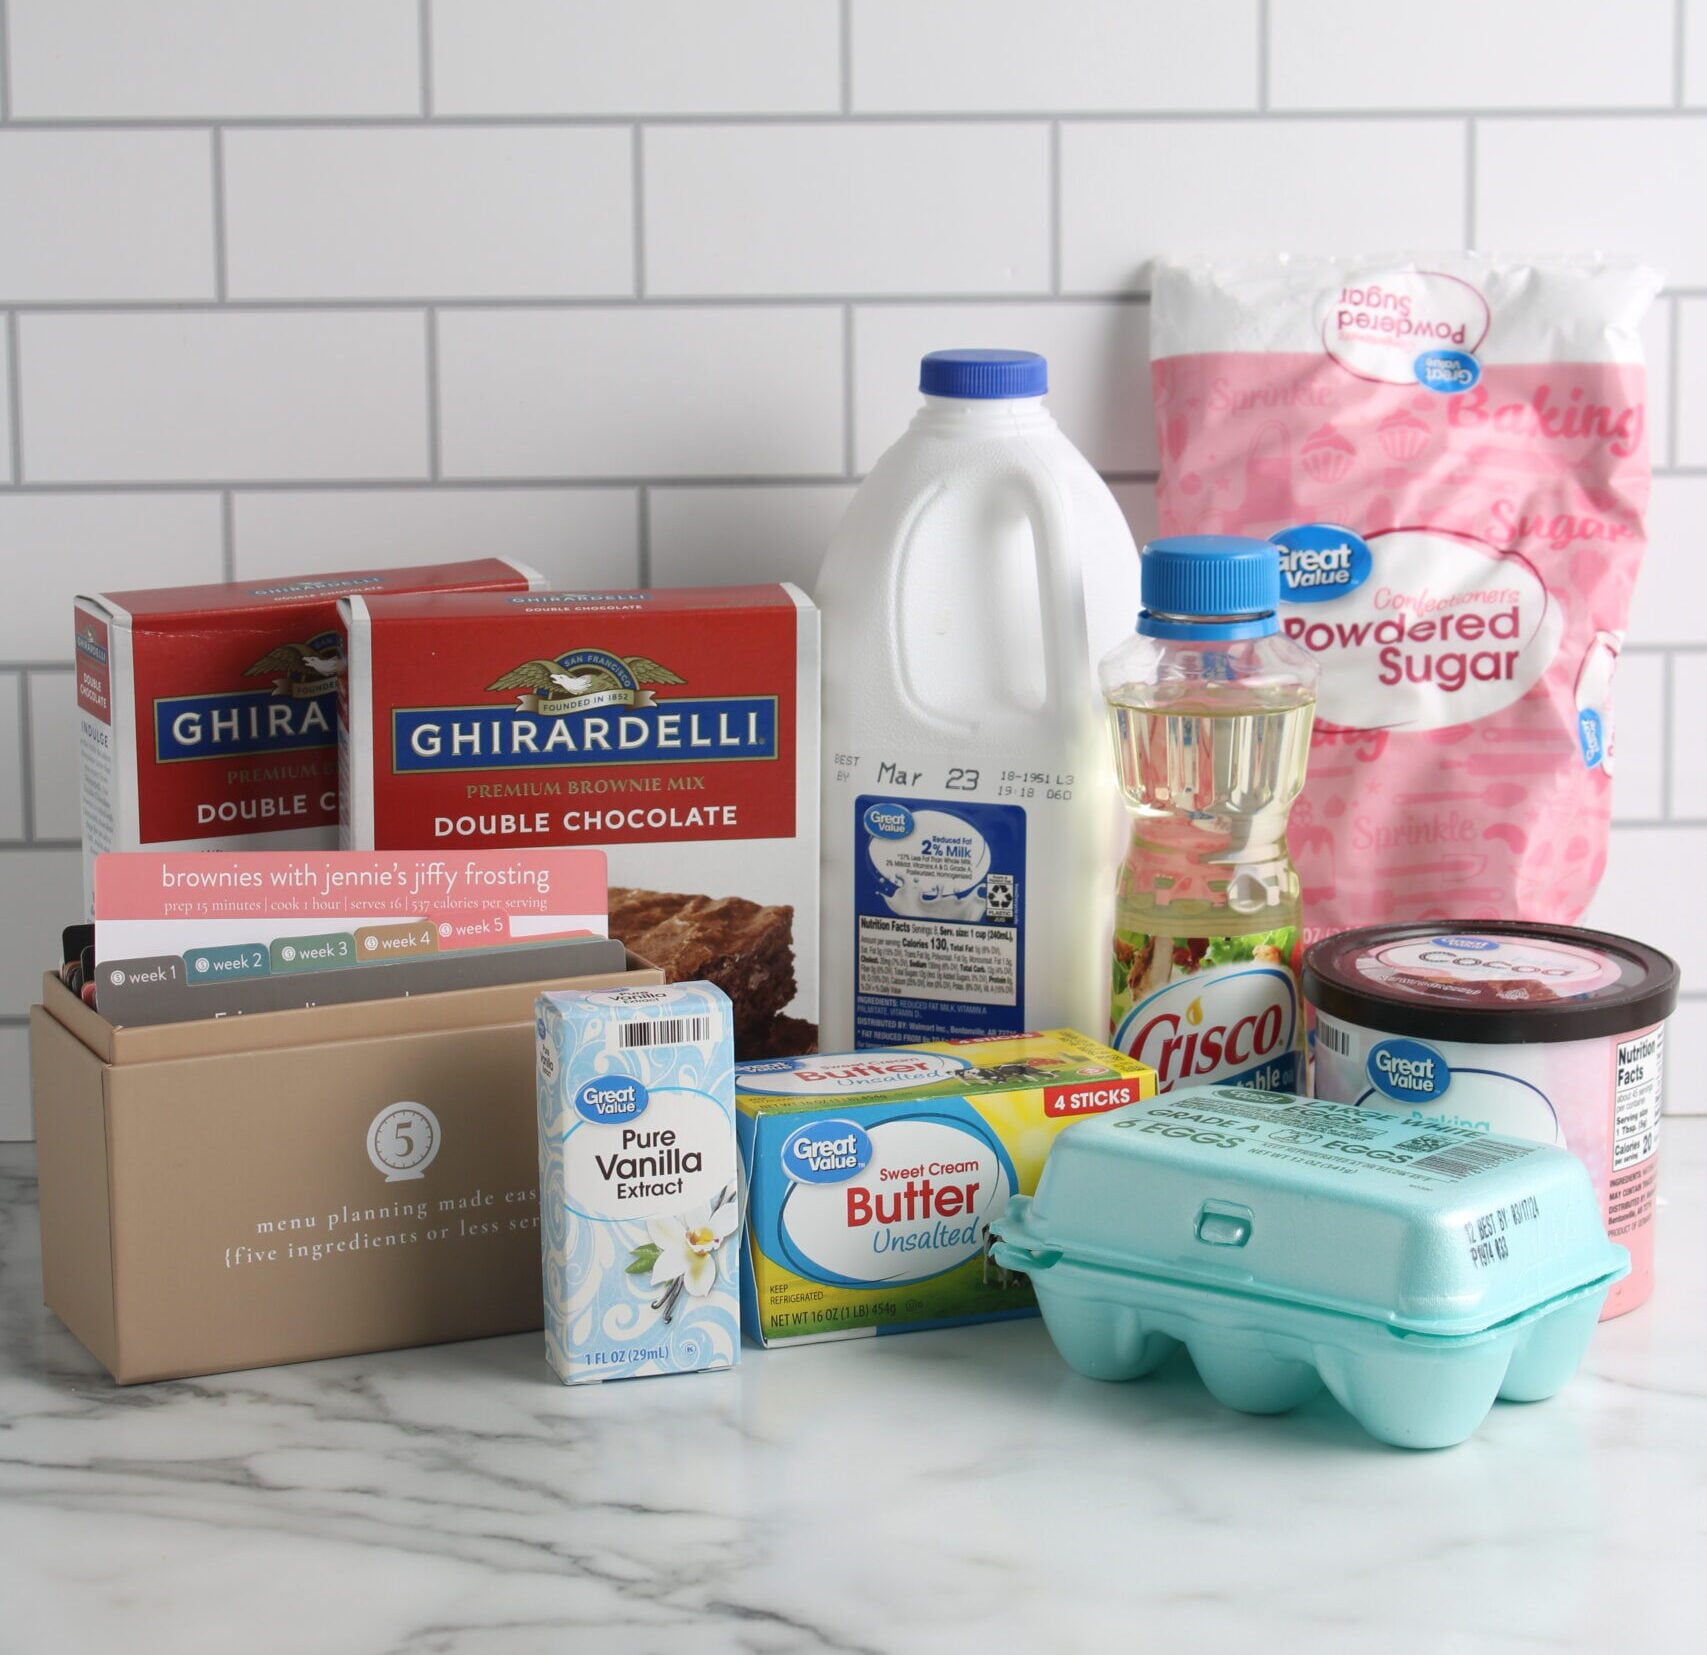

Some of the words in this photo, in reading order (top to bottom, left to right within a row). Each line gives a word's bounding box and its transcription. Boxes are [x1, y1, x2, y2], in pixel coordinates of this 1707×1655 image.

[1209, 376, 1333, 415] Sprinkle
[1447, 385, 1645, 457] Baking
[1486, 500, 1636, 550] Sugar
[1285, 569, 1351, 588] Value
[512, 593, 647, 602] GHIRARDELLI
[574, 604, 643, 612] CHOCOLATE
[1374, 587, 1520, 617] Confectioners
[1283, 607, 1520, 652] Powdered
[563, 655, 583, 668] SAN
[587, 654, 631, 688] FRANCISCO
[1378, 646, 1520, 692] Sugar
[543, 698, 590, 712] FOUNDED
[593, 695, 604, 704] IN
[608, 692, 629, 702] 1852
[81, 720, 109, 749] INDULGE
[172, 701, 330, 746] GHIRA
[411, 711, 759, 758] GHIRARDELLI
[834, 754, 860, 767] BEST
[227, 767, 317, 785] PREMIUM
[466, 781, 562, 799] PREMIUM
[568, 777, 662, 795] BROWNIE
[668, 776, 705, 790] MIX
[837, 770, 849, 782] BY
[877, 761, 923, 787] Mar
[945, 768, 980, 791] 23
[197, 795, 308, 824] DOUBLE
[435, 812, 550, 837] DOUBLE
[563, 805, 738, 832] CHOCOLATE
[870, 810, 905, 825] Great
[878, 822, 905, 833] Value
[1352, 811, 1477, 849] Sprinkle
[921, 840, 943, 856] 2%
[946, 845, 972, 858] Milk
[932, 835, 961, 845] Reduced
[963, 836, 972, 845] Fat
[162, 863, 262, 887] brownies
[270, 863, 317, 887] with
[410, 862, 458, 894] jiffy
[465, 862, 551, 893] frosting
[164, 901, 193, 916] prep
[197, 902, 208, 914] 15
[211, 899, 261, 912] minutes
[271, 897, 300, 911] cook
[312, 896, 339, 910] hour
[350, 899, 386, 911] serves
[389, 897, 402, 909] 16
[411, 900, 430, 914] 537
[434, 895, 479, 909] calories
[482, 899, 501, 914] per
[504, 897, 548, 912] serving
[456, 918, 491, 936] week
[494, 917, 503, 931] 5
[861, 917, 890, 931] Nutrition
[892, 920, 910, 932] Facts
[975, 930, 986, 940] cup
[299, 943, 335, 960] week
[338, 941, 348, 956] 3
[382, 933, 417, 949] week
[420, 931, 430, 945] 4
[902, 937, 928, 949] Calories
[950, 943, 964, 952] Total
[965, 944, 974, 953] Fat
[213, 955, 249, 971] week
[253, 952, 262, 967] 2
[1420, 951, 1575, 977] Cocoa
[129, 967, 167, 985] week
[170, 965, 177, 979] 1
[609, 992, 667, 1002] Vanilla
[1127, 1003, 1283, 1093] Crisco
[1618, 1040, 1655, 1067] Nutrition
[794, 1061, 930, 1083] Butter
[820, 1062, 865, 1071] Sweet
[1375, 1049, 1435, 1080] Great
[1617, 1065, 1644, 1087] Facts
[837, 1070, 944, 1087] Unsalted
[1388, 1072, 1434, 1093] Value
[583, 1084, 636, 1106] Great
[1055, 1094, 1066, 1110] 4
[1070, 1087, 1131, 1110] STICKS
[596, 1100, 636, 1116] Value
[1283, 1105, 1368, 1124] EGGS
[1616, 1112, 1639, 1126] Serving
[1303, 1101, 1399, 1122] LARGE
[1400, 1117, 1488, 1139] WHITE
[394, 1120, 415, 1157] 5
[622, 1129, 676, 1150] Pure
[1113, 1119, 1138, 1129] 6
[1139, 1122, 1246, 1149] EGGS
[1147, 1108, 1241, 1129] GRADE
[1237, 1124, 1261, 1134] A
[1322, 1140, 1414, 1163] EGGS
[1615, 1139, 1641, 1156] Calories
[1642, 1132, 1653, 1155] 20
[793, 1134, 857, 1160] Great
[595, 1148, 702, 1181] Vanilla
[809, 1154, 857, 1172] Value
[880, 1163, 924, 1182] Sweet
[928, 1160, 979, 1177] Cream
[617, 1177, 683, 1200] Extract
[256, 1212, 317, 1234] menu
[327, 1200, 429, 1231] planning
[438, 1188, 495, 1212] made
[505, 1187, 537, 1203] eas
[847, 1178, 980, 1228] Butter
[873, 1216, 980, 1254] Unsalted
[1477, 1213, 1497, 1240] BEST
[1497, 1207, 1509, 1231] BY
[287, 1230, 417, 1261] ingredients
[426, 1227, 449, 1242] or
[460, 1217, 499, 1237] less
[509, 1215, 540, 1231] ser
[769, 1284, 788, 1295] KEEP
[770, 1291, 824, 1305] REFRIGERATED
[771, 1312, 790, 1328] NET
[792, 1311, 809, 1327] WT
[812, 1308, 824, 1323] 16
[825, 1308, 840, 1322] OZ
[840, 1307, 850, 1323] (1
[852, 1303, 869, 1321] LB)
[872, 1302, 897, 1318] 454g
[585, 1353, 590, 1365] 1
[594, 1351, 607, 1364] FL
[611, 1350, 625, 1363] OZ
[628, 1346, 670, 1364] (29mL)
